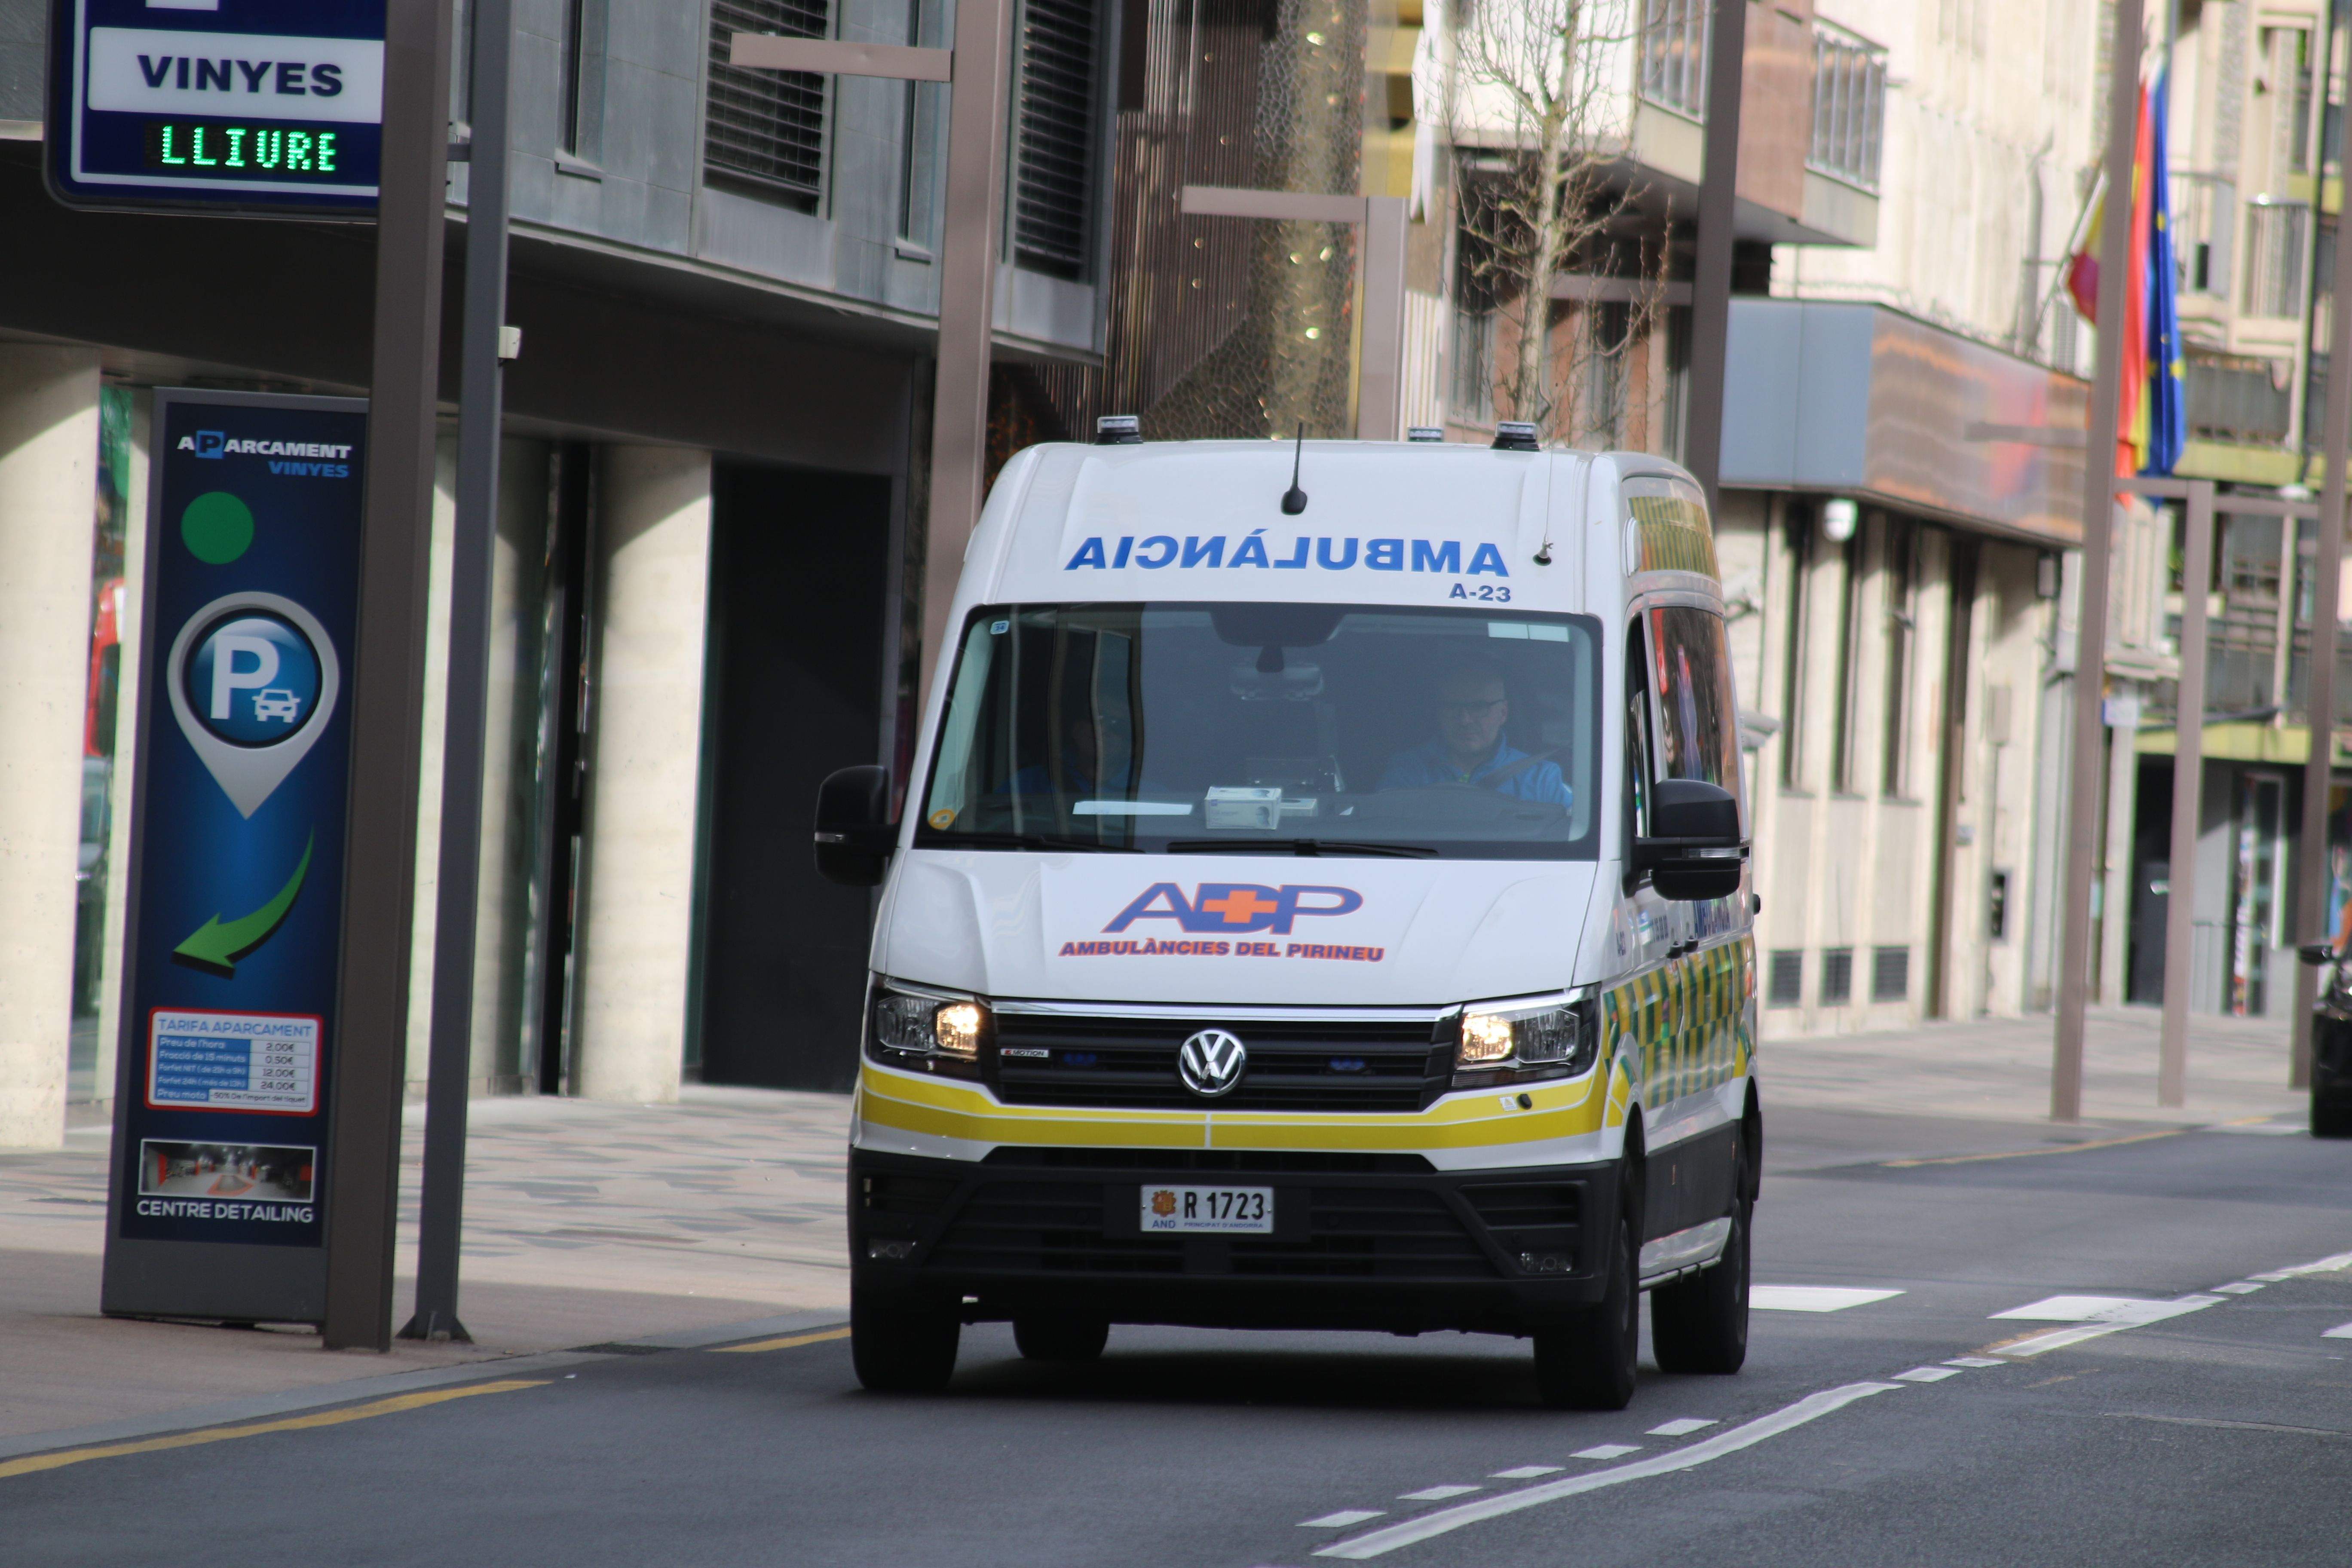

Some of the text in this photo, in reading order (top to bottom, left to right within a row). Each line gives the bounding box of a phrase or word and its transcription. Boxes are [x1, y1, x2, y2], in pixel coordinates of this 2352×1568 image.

[137, 55, 343, 97] VINYES
[162, 126, 337, 171] LLIURE
[269, 461, 349, 478] VINYES
[1449, 583, 1511, 603] A-23
[210, 635, 279, 720] P
[1058, 937, 1384, 962] AMBULÀNCIES DEL PIRINEU
[159, 1019, 312, 1037] TARIFA APARCAMENT
[159, 1037, 183, 1047] Preu
[184, 1039, 197, 1047] de
[266, 1043, 294, 1052] 2.00€
[192, 1052, 204, 1060] de
[263, 1068, 294, 1078] 12.00€
[157, 1089, 181, 1098] Preu
[181, 1090, 207, 1099] moto
[260, 1081, 295, 1091] 24.00€
[137, 1200, 313, 1223] CENTRE DETAILING
[1184, 1191, 1264, 1220] R 1723
[1152, 1220, 1176, 1229] AND
